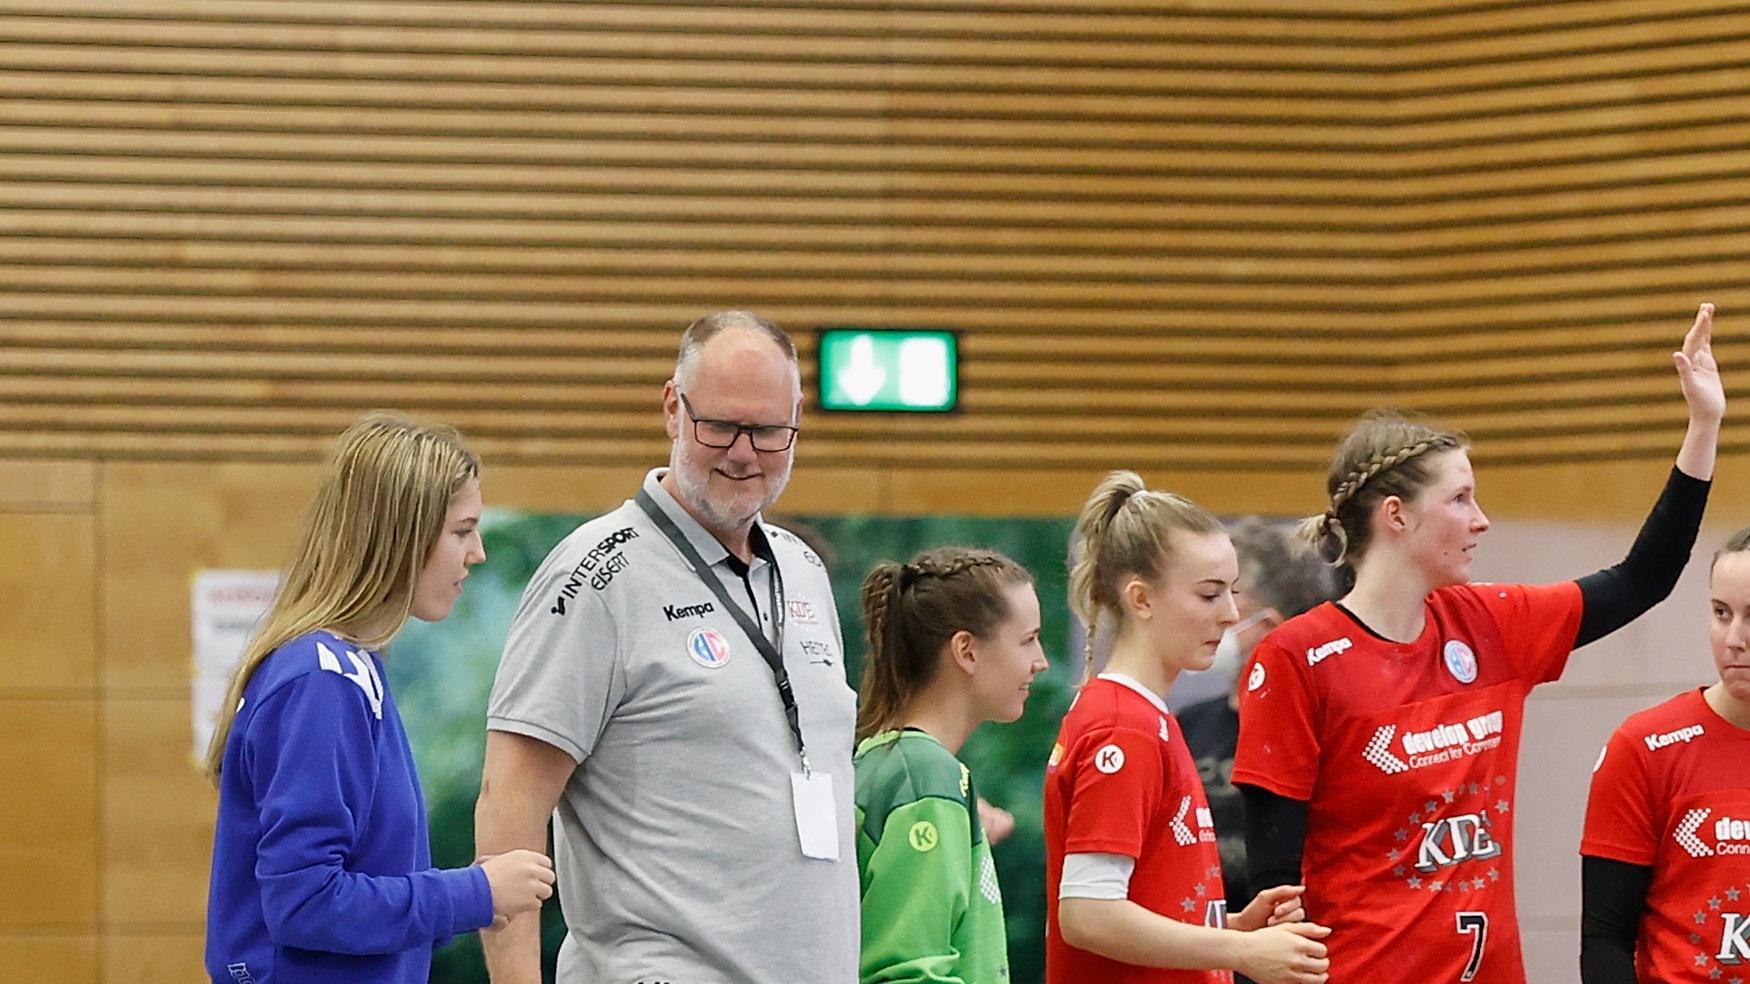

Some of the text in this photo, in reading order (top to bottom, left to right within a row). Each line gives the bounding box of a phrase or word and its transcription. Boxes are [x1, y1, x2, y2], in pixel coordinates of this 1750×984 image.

[562, 526, 640, 599] INTERSPORT
[591, 551, 630, 591] EISERT
[663, 602, 714, 621] Kempa
[1307, 637, 1353, 667] Kempa
[1402, 723, 1469, 755] develop
[1644, 724, 1704, 751] Kempa
[1456, 911, 1488, 982] 7
